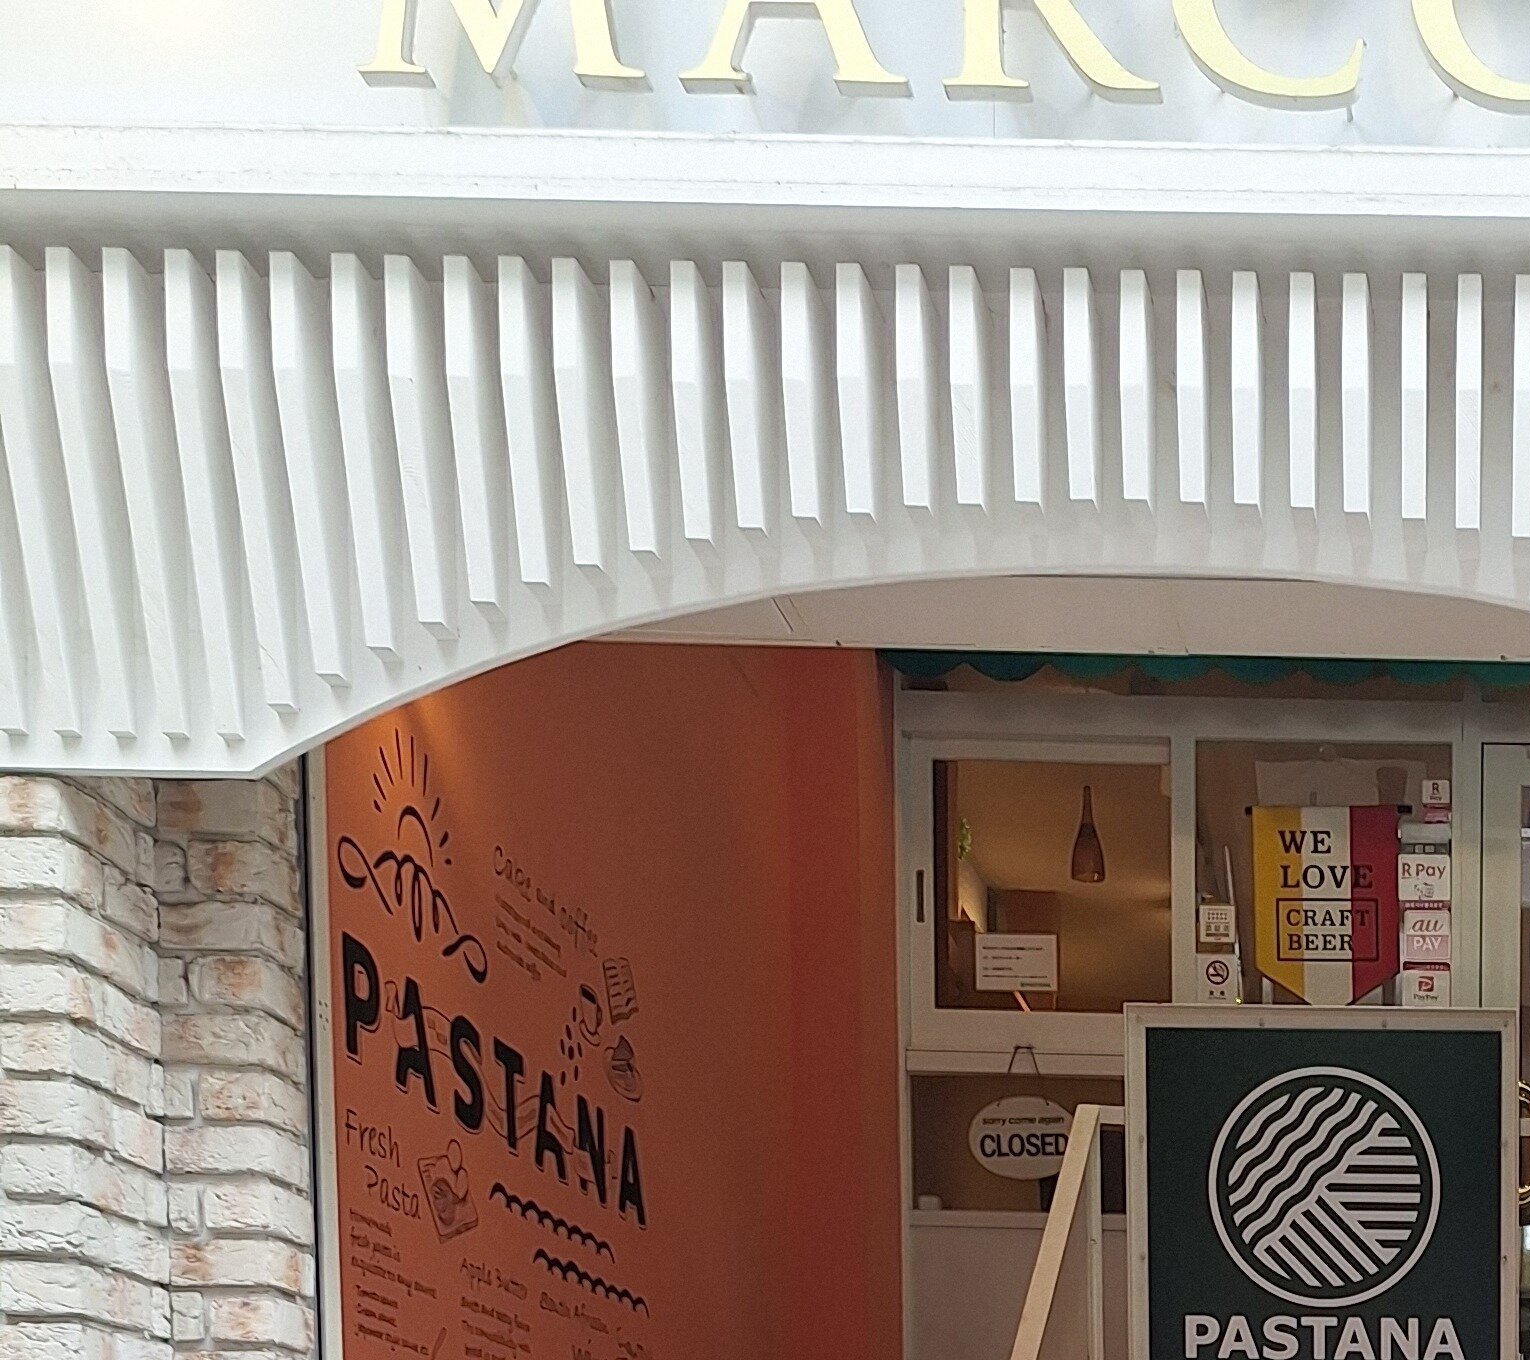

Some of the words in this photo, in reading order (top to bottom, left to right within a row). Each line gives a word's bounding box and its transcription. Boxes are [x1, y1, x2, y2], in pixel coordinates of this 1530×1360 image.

[1278, 829, 1333, 855] WE
[1279, 863, 1374, 890] LOVE
[1416, 863, 1447, 880] Pay
[1285, 907, 1370, 929] CRAFT
[1412, 918, 1445, 933] au
[1287, 931, 1355, 952] BEER
[1413, 936, 1442, 951] PAY
[342, 930, 648, 1231] PASTANA
[345, 1109, 400, 1168] Fresh
[980, 1133, 1069, 1158] CLOSED
[364, 1165, 421, 1220] Pasta
